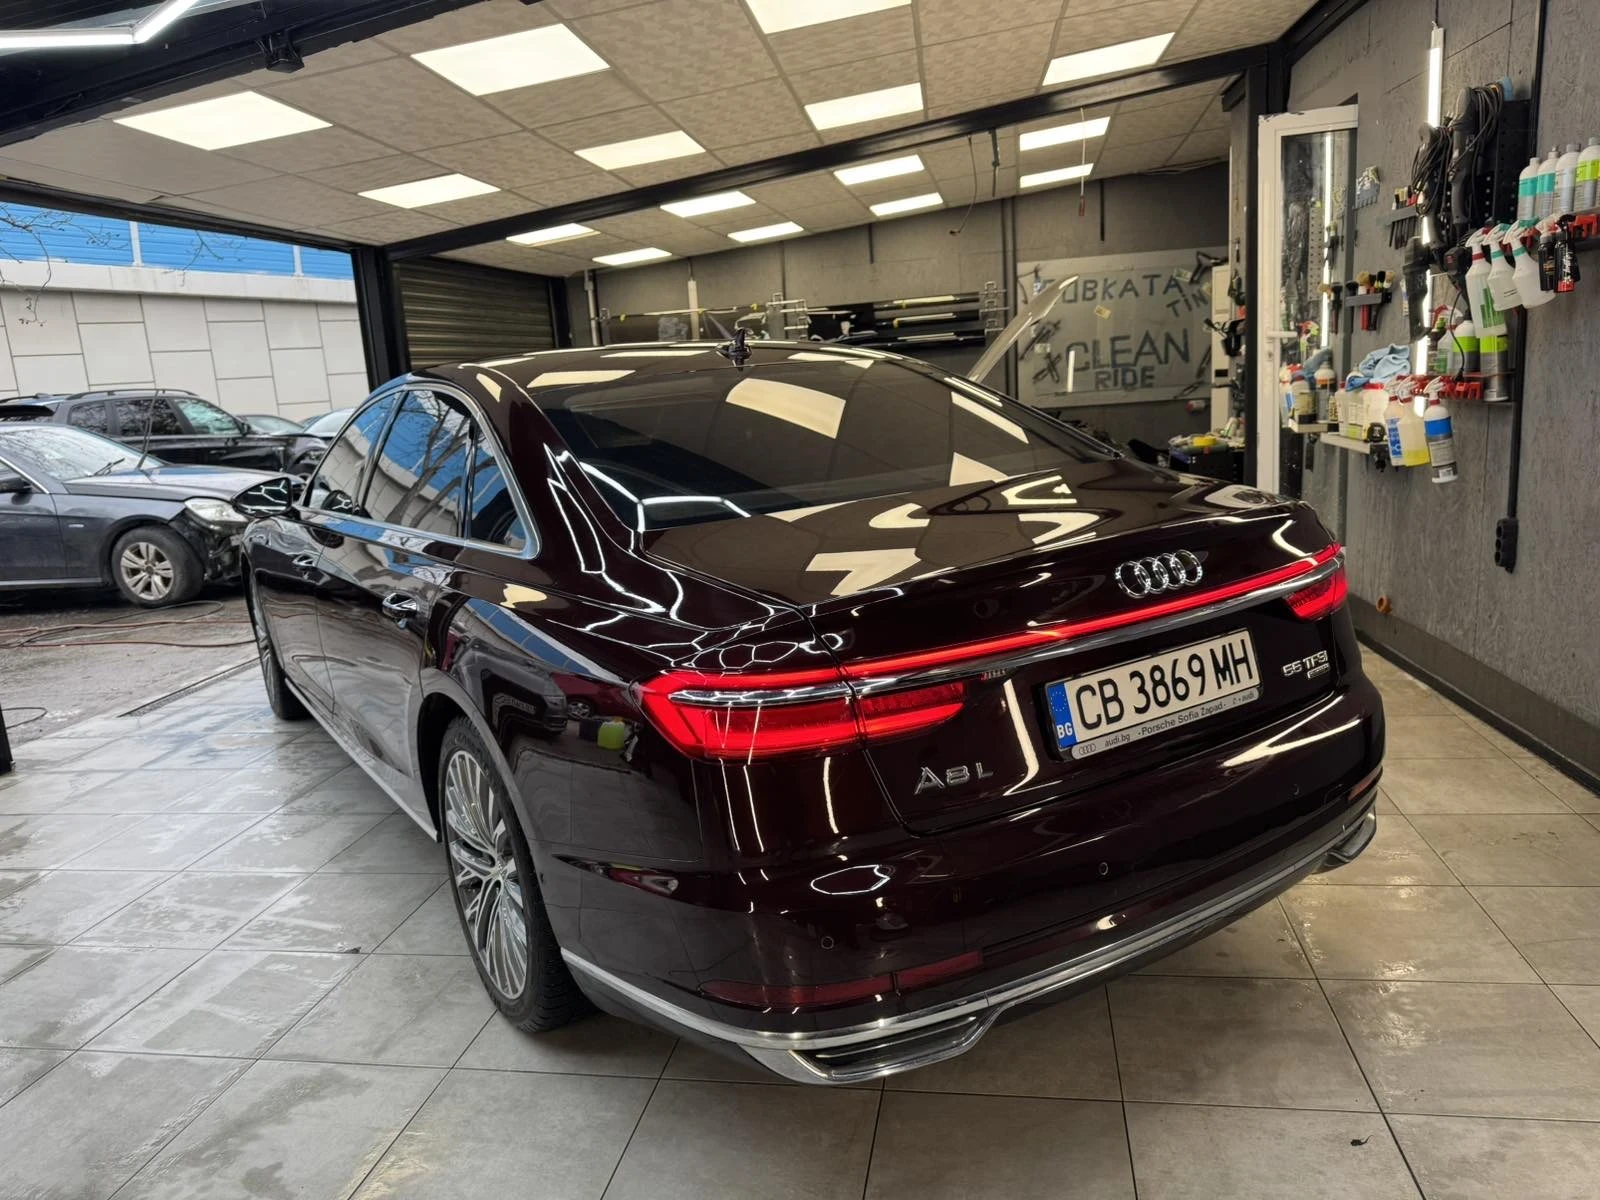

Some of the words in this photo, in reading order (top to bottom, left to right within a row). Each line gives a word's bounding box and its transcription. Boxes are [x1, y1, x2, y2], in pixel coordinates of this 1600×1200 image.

[1066, 328, 1191, 373] CLEAN
[1094, 365, 1156, 391] RIDE
[1076, 678, 1125, 730] CB
[1129, 653, 1206, 715] 3869
[1209, 639, 1254, 690] MH
[1056, 721, 1073, 739] BG
[1104, 732, 1131, 749] audi.bg
[1141, 718, 1177, 737] Porsche
[1177, 711, 1200, 725] Sofia
[1201, 701, 1224, 719] Zapad
